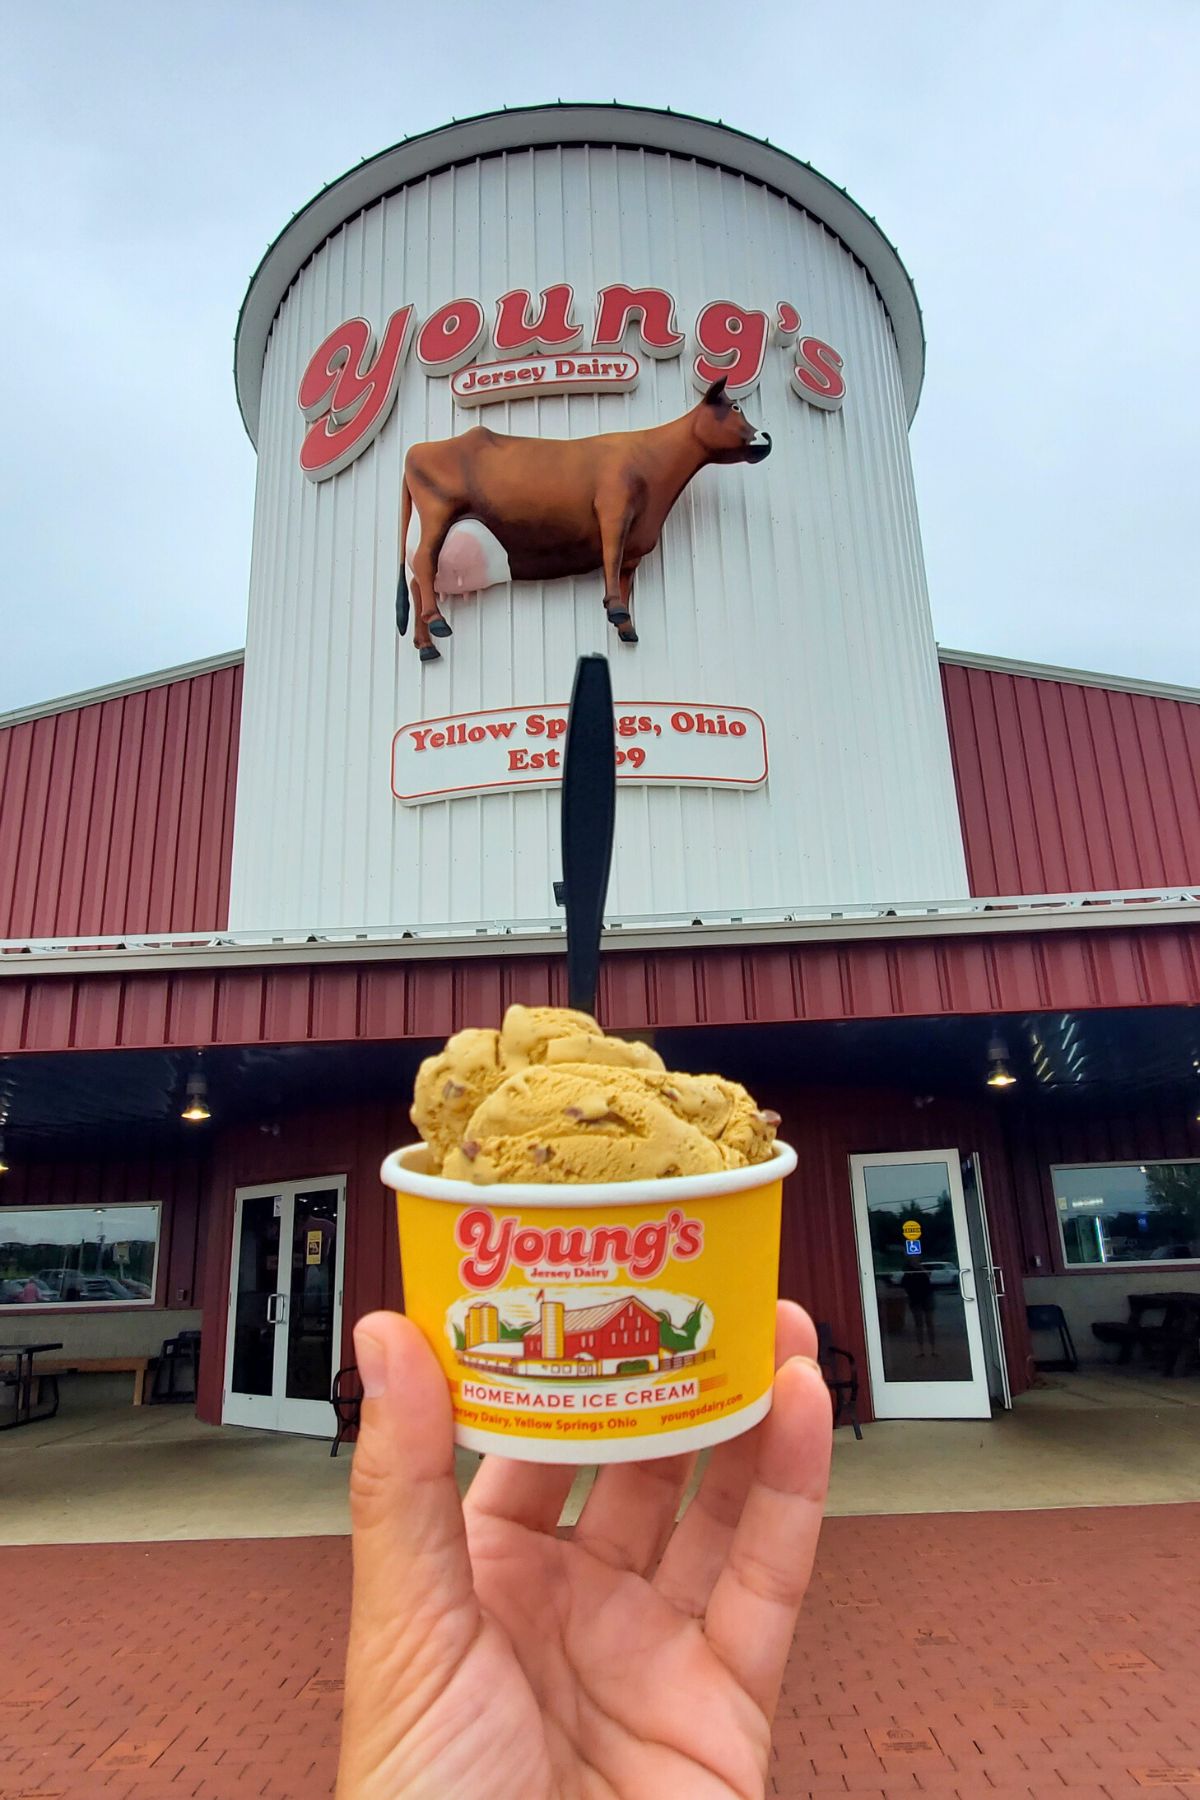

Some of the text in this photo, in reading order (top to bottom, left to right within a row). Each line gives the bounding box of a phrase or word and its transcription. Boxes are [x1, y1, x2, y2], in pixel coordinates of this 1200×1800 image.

[298, 283, 846, 473] Young's
[462, 359, 629, 389] Jersey Dairy
[409, 711, 747, 752] Yellow Spgs, Ohio
[508, 748, 560, 771] Est
[457, 1208, 704, 1289] Young's
[530, 1267, 609, 1280] Jersey Dairy
[464, 1382, 695, 1408] HOMEMADE ICE CREAM
[660, 1393, 743, 1425] youngsdairy.com
[453, 1406, 479, 1423] ersey
[514, 1417, 552, 1430] Yellow
[556, 1419, 604, 1432] Springs
[607, 1418, 637, 1429] Ohio
